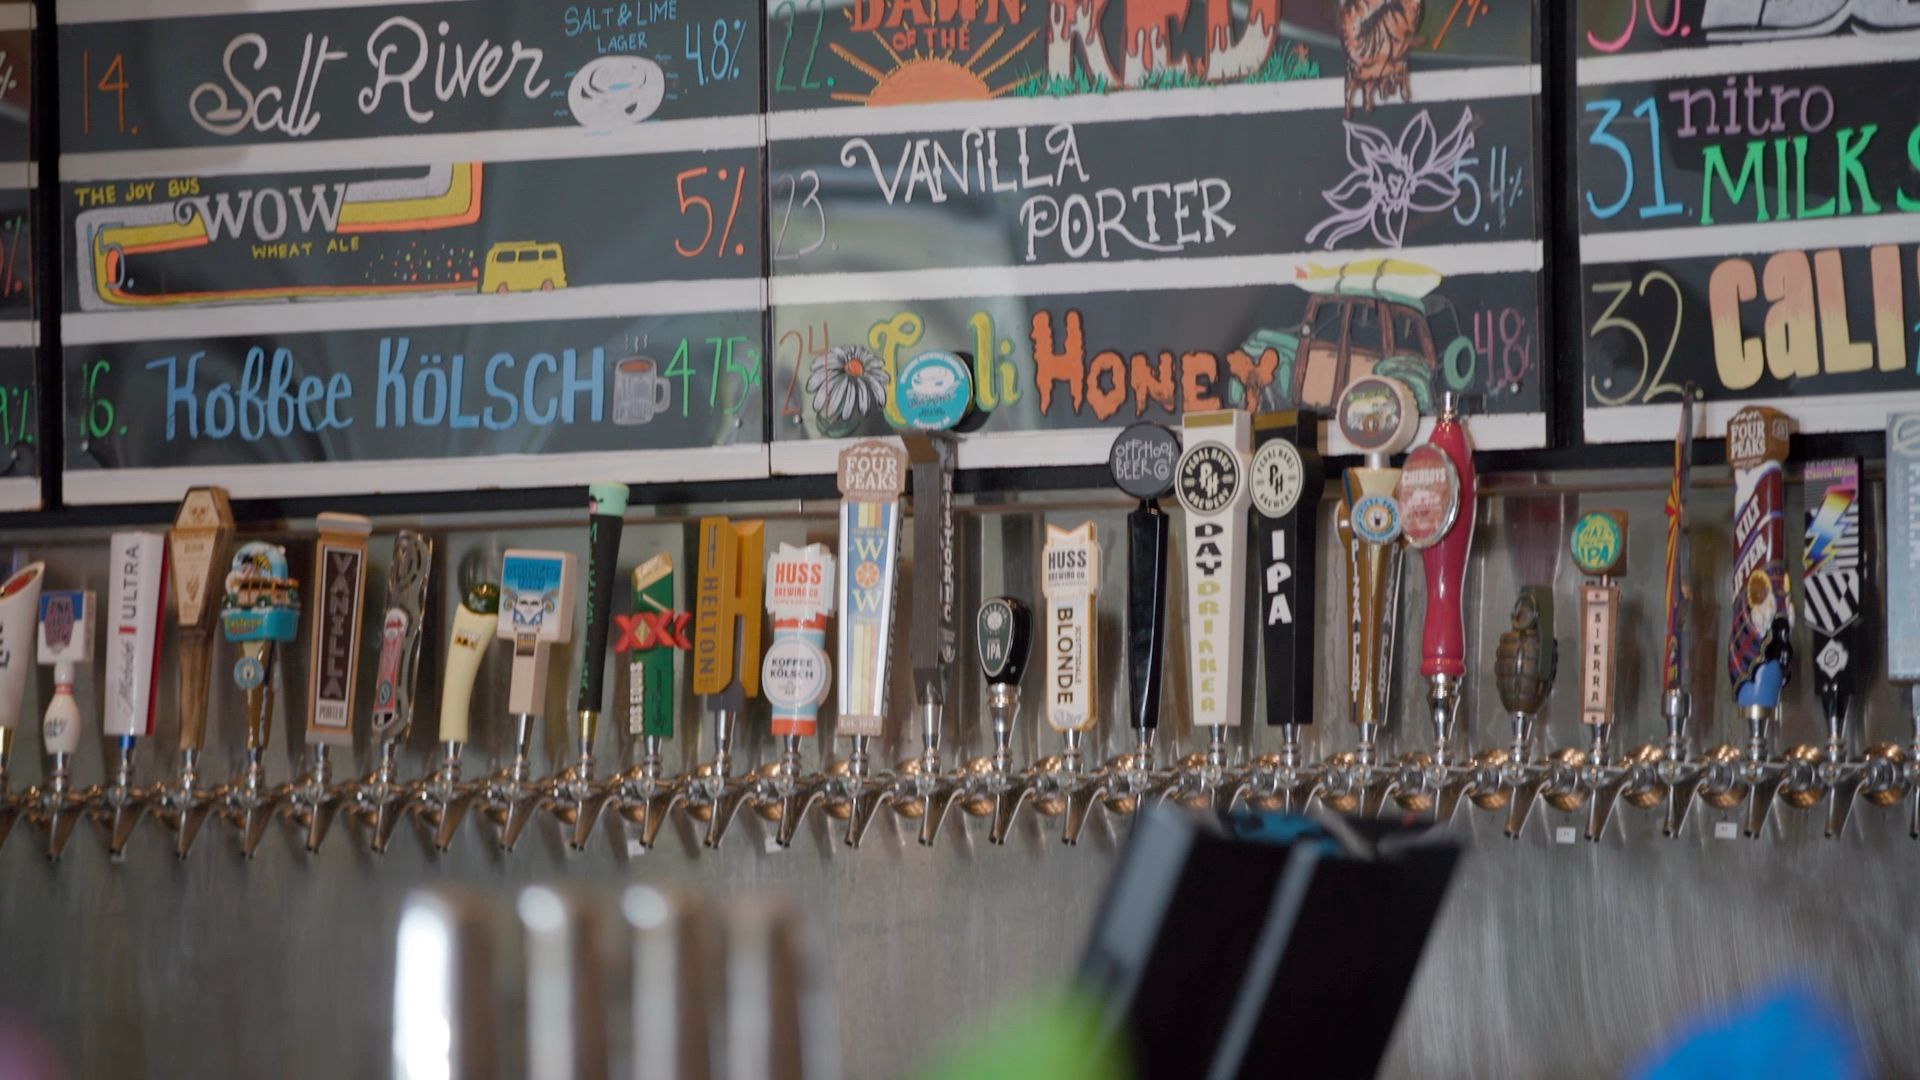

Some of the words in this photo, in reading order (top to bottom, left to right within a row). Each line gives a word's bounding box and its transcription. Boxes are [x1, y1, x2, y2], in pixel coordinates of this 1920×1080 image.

[564, 6, 614, 37] SALT
[617, 3, 632, 27] &
[636, 0, 678, 26] LIME
[597, 32, 648, 53] LAGER
[891, 30, 918, 52] OF
[922, 26, 970, 51] THE
[83, 48, 139, 135] 14.
[189, 32, 347, 136] Salt
[358, 16, 550, 123] River
[685, 18, 747, 86] 4.8%
[1668, 74, 1835, 138] nitro
[75, 187, 116, 207] THE
[124, 182, 156, 201] JOY
[168, 177, 200, 197] BUS
[1700, 124, 1882, 225] MILK
[195, 182, 348, 242] WOW
[675, 166, 746, 259] 5%
[1020, 178, 1236, 262] PORTER
[252, 244, 313, 260] WHEAT
[326, 237, 360, 254] ALE
[145, 346, 354, 441] Koffee
[376, 337, 605, 430] KÖLSCH
[868, 310, 1022, 430] Cli
[1730, 420, 1765, 442] FOUR
[1730, 438, 1766, 460] PEAKS
[844, 472, 898, 491] PEAKS
[846, 456, 898, 475] FOUR
[1116, 458, 1152, 481] BEER
[1735, 494, 1760, 549] KILT
[775, 561, 822, 585] HUSS
[1048, 549, 1087, 570] HUSS
[1195, 523, 1224, 577] DAY
[122, 543, 139, 621] ULTRA
[1266, 529, 1293, 626] IPA
[700, 577, 719, 674] HELTON
[986, 642, 1001, 660] IPA
[771, 657, 813, 668] KOFFEE
[1057, 607, 1074, 704] BLONDE
[1592, 612, 1602, 703] SIERRA
